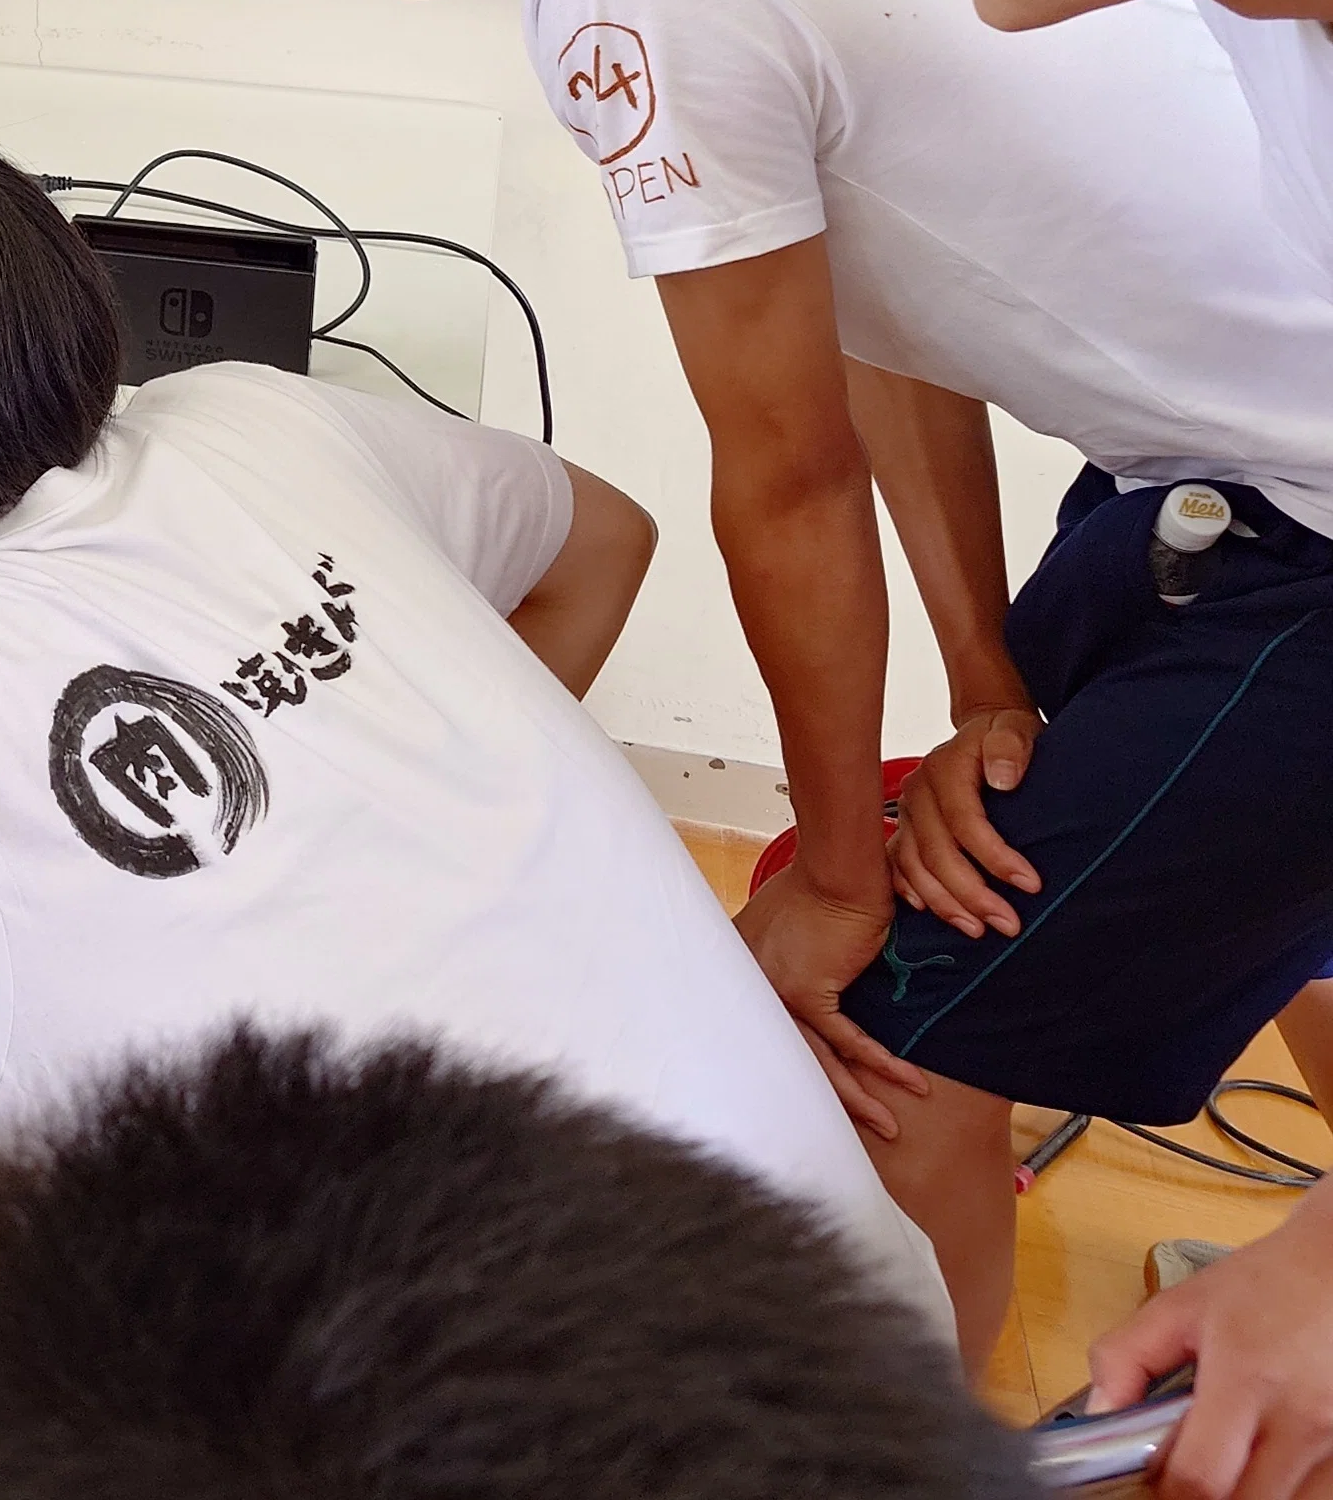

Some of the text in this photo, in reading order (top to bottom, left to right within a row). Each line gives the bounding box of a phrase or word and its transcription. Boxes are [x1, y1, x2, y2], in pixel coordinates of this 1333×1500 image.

[602, 152, 701, 219] PEN
[146, 348, 215, 365] SWITC
[1178, 497, 1225, 520] Mets
